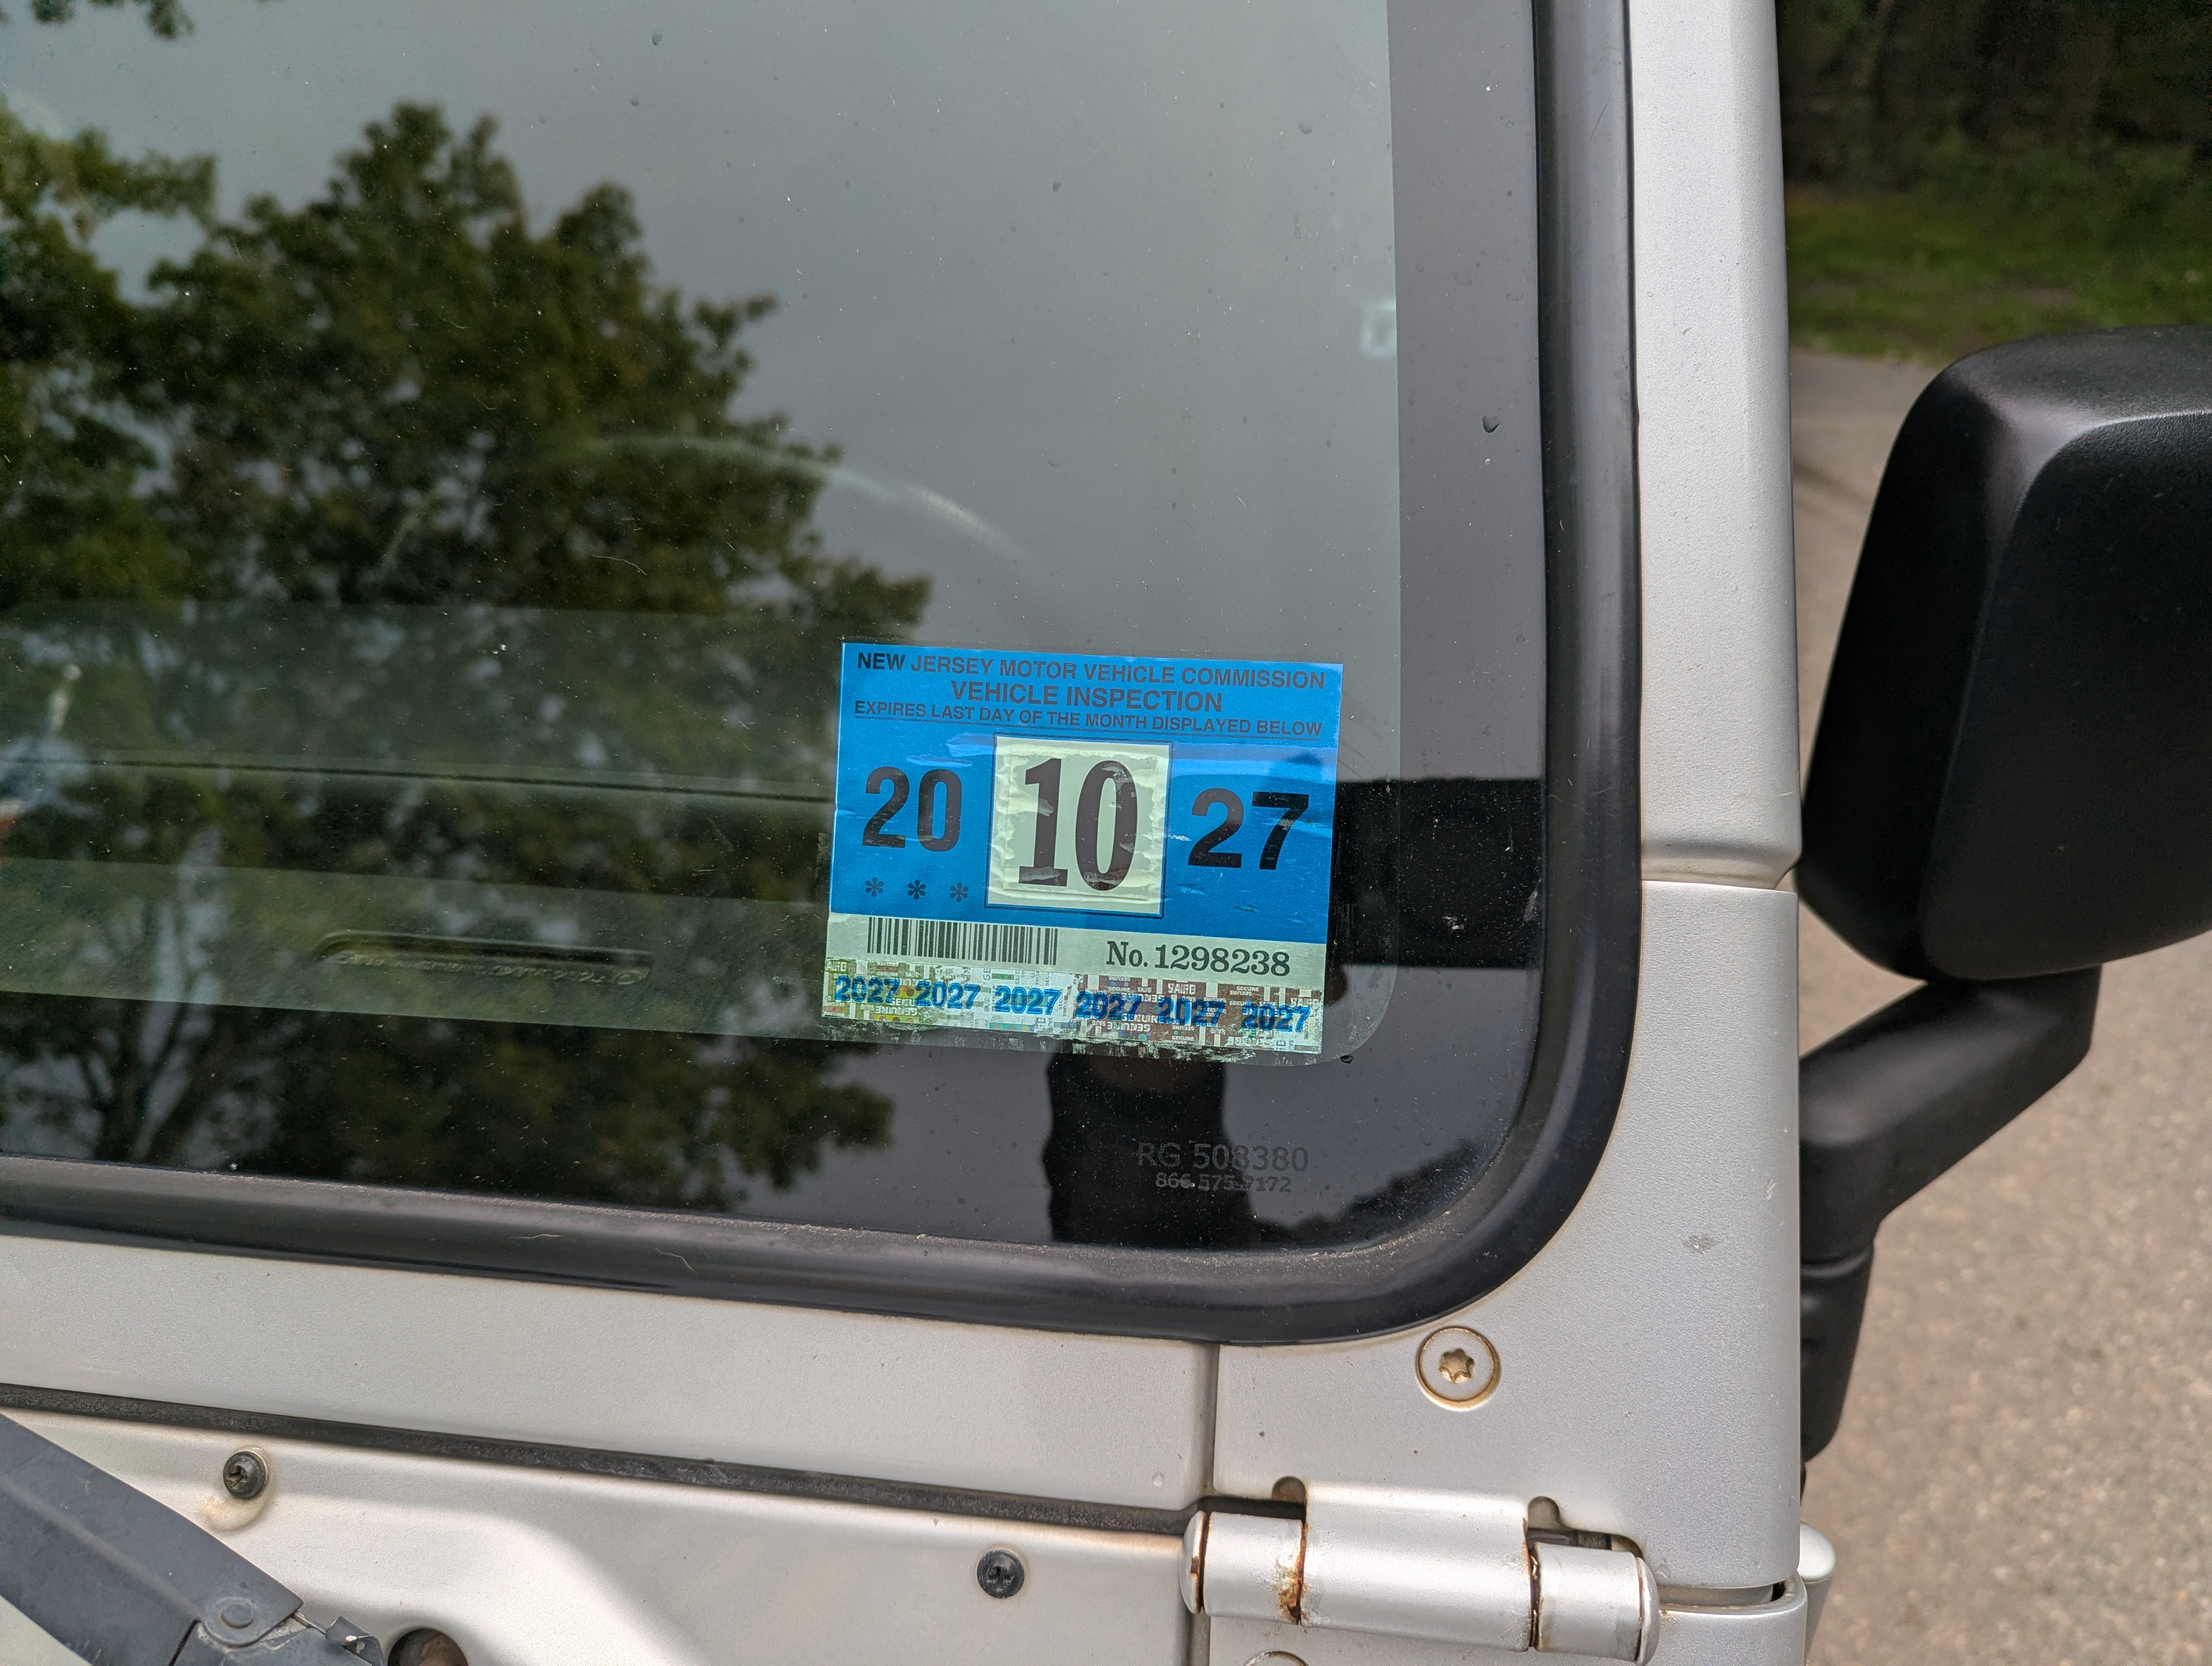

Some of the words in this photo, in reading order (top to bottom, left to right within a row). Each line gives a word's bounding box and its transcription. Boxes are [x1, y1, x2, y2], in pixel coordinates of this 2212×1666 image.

[857, 652, 905, 670] NEW
[911, 655, 994, 676] JERSEY
[999, 659, 1077, 679] MOTOR
[1083, 663, 1175, 684] VEHICLE
[1181, 667, 1325, 689] COMMISSION
[951, 681, 1059, 705] VEHICLE
[1066, 687, 1222, 712] INSPECTION
[855, 701, 926, 717] EXPIRES
[931, 705, 975, 720] LAST
[979, 707, 1015, 722] DAY
[1019, 710, 1042, 724] OF
[1047, 712, 1081, 726] THE
[1085, 713, 1147, 730] MONTH
[1152, 716, 1251, 734] DISPLAYED
[1256, 720, 1323, 736] BELOW
[861, 766, 963, 853] 20
[1018, 757, 1138, 892] 10
[1188, 787, 1309, 870] 27
[834, 975, 901, 1003] 2027
[915, 980, 981, 1010] 2027
[994, 985, 1061, 1015] 2027
[1075, 990, 1142, 1021] 2027
[1158, 996, 1226, 1027] 2027
[1242, 1002, 1311, 1033] 2027
[1137, 1142, 1181, 1168] RG
